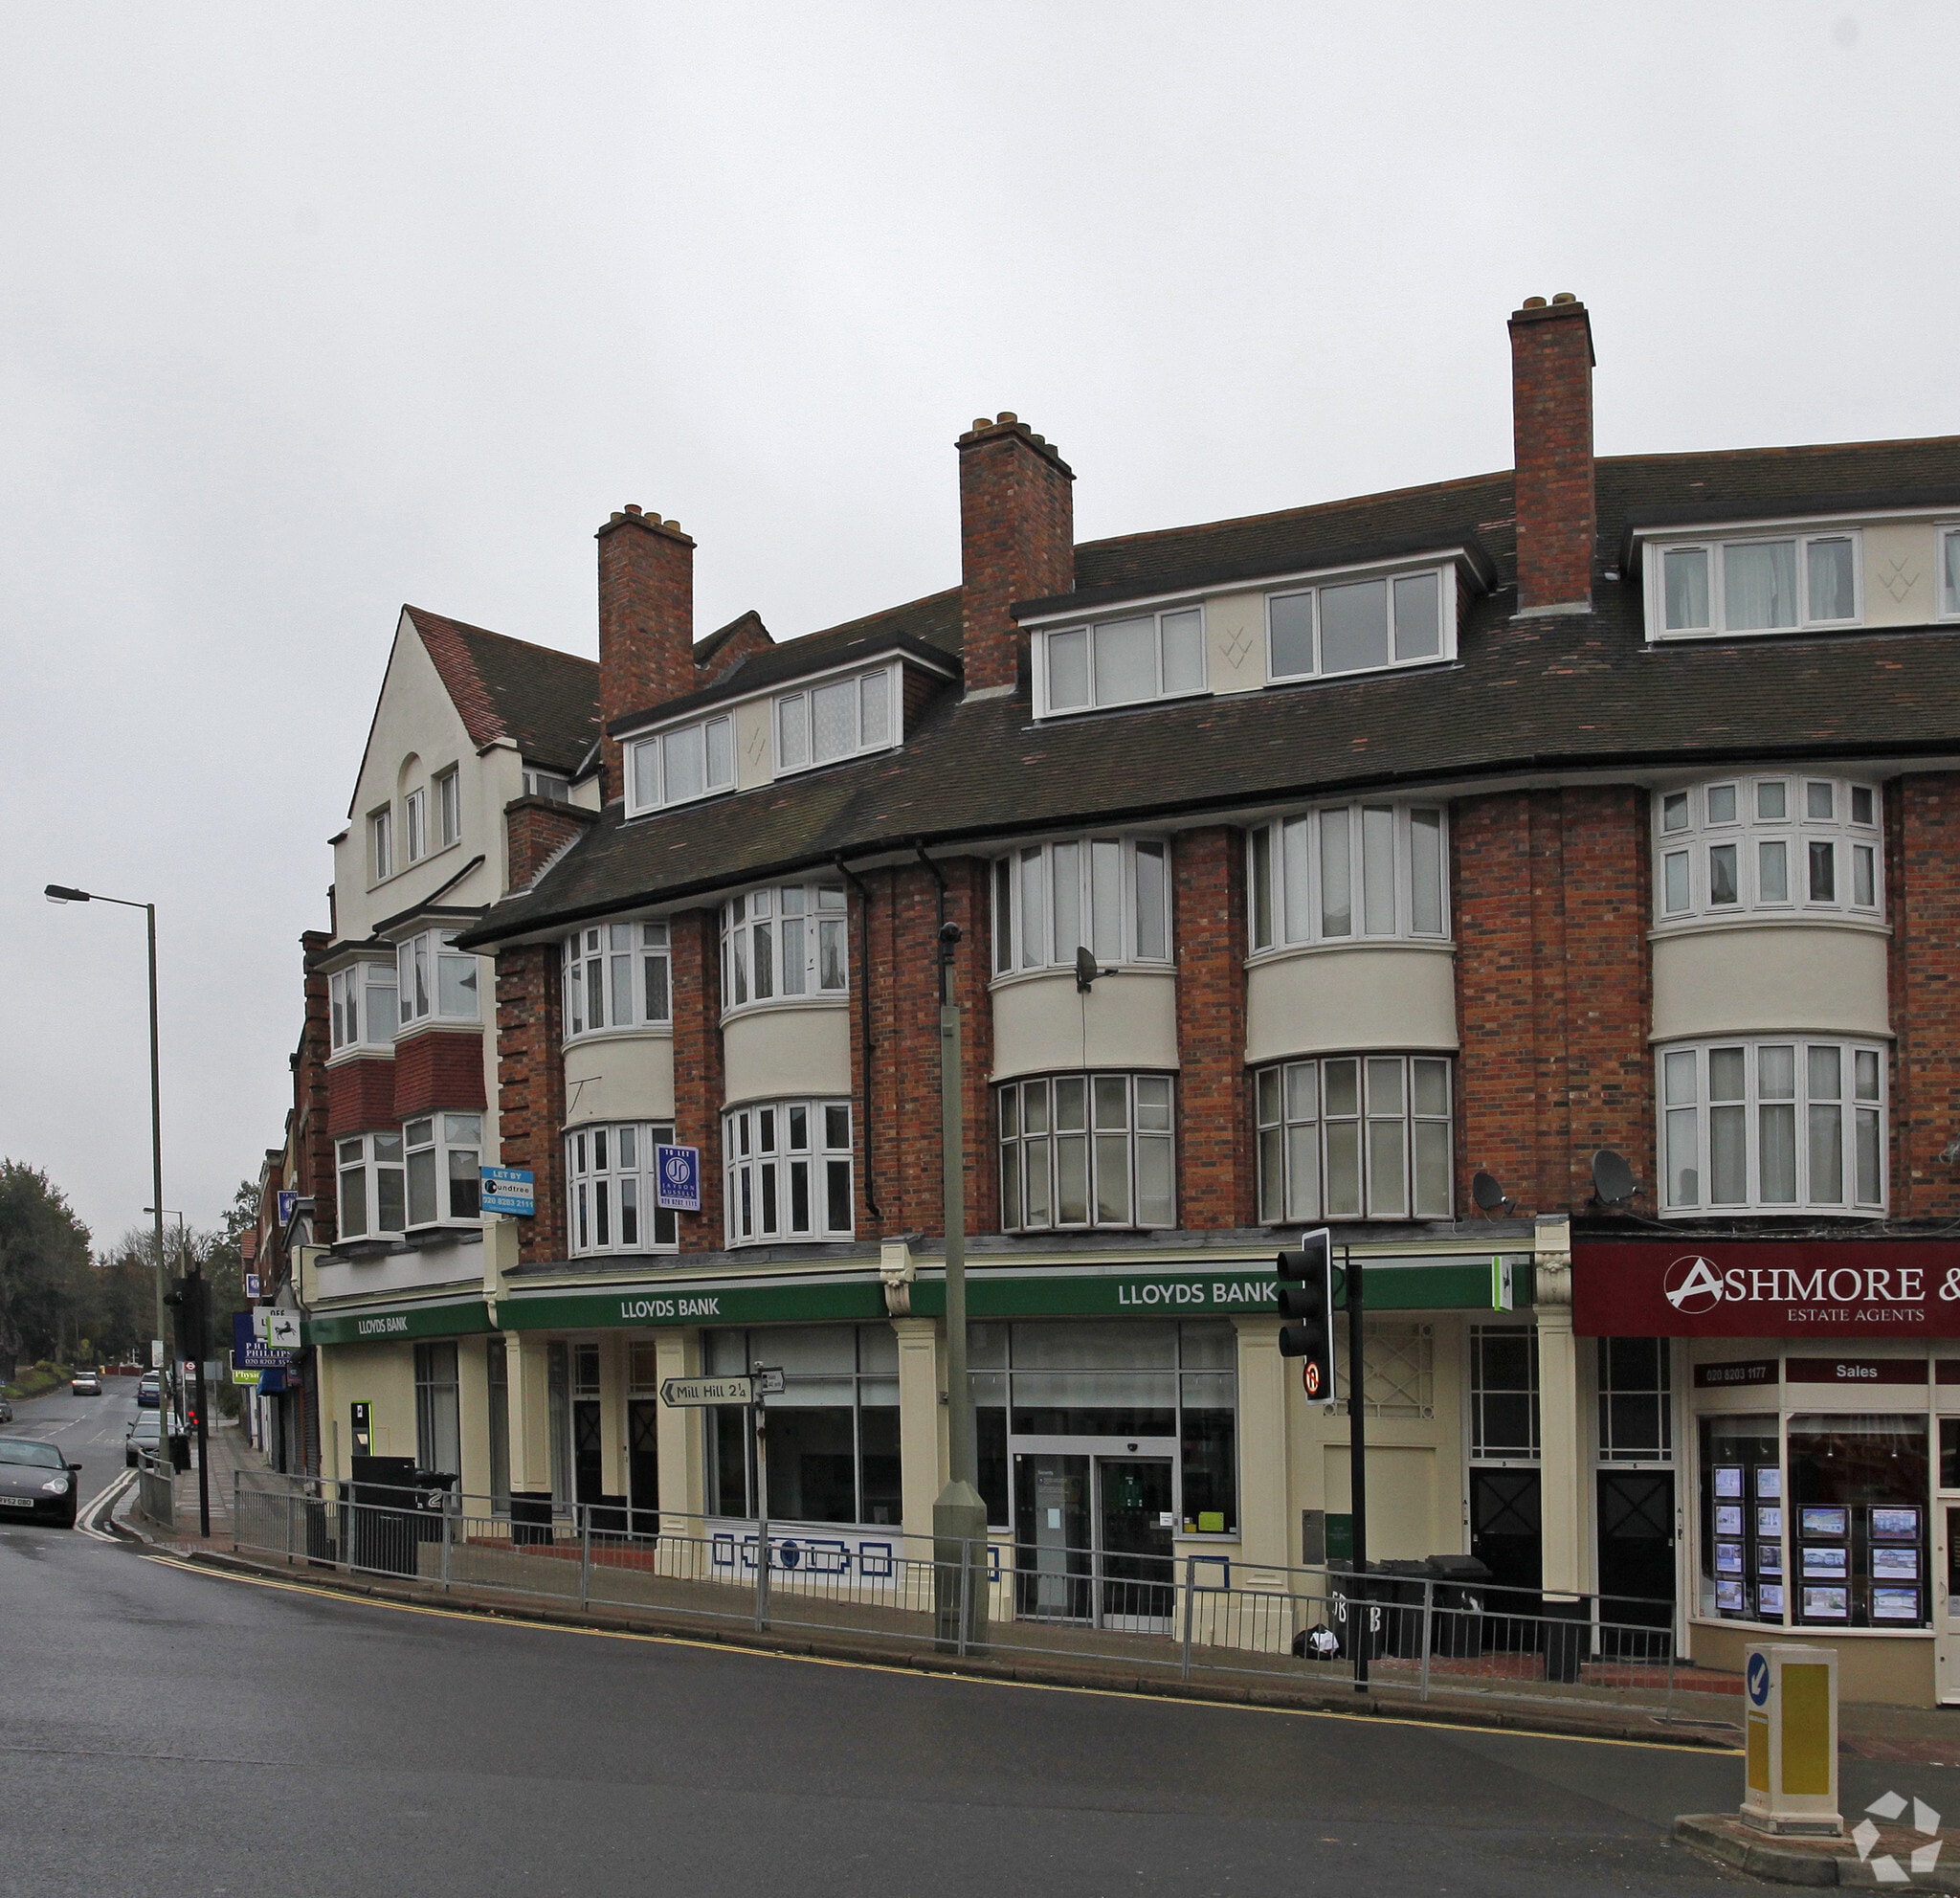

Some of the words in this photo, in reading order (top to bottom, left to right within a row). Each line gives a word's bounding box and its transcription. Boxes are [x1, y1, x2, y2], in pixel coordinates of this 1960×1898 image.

[493, 1170, 508, 1178] LET
[510, 1172, 522, 1180] BY
[1665, 1256, 1926, 1308] ASHMORE
[1119, 1284, 1205, 1306] LLOYDS
[1213, 1282, 1279, 1303] BANK
[621, 1300, 675, 1318] LLOYDS
[678, 1298, 720, 1316] BANK
[1788, 1308, 1850, 1322] ESTATE
[1855, 1308, 1925, 1323] AGENTS
[359, 1318, 386, 1334] LLOYDS
[386, 1316, 408, 1331] BANK
[1706, 1370, 1723, 1381] 020
[1724, 1369, 1746, 1381] 8203
[1748, 1367, 1767, 1379] 1177
[1837, 1365, 1878, 1378] Sales
[678, 1386, 700, 1398] Mill
[703, 1385, 724, 1397] Hill
[429, 1488, 443, 1507] 2
